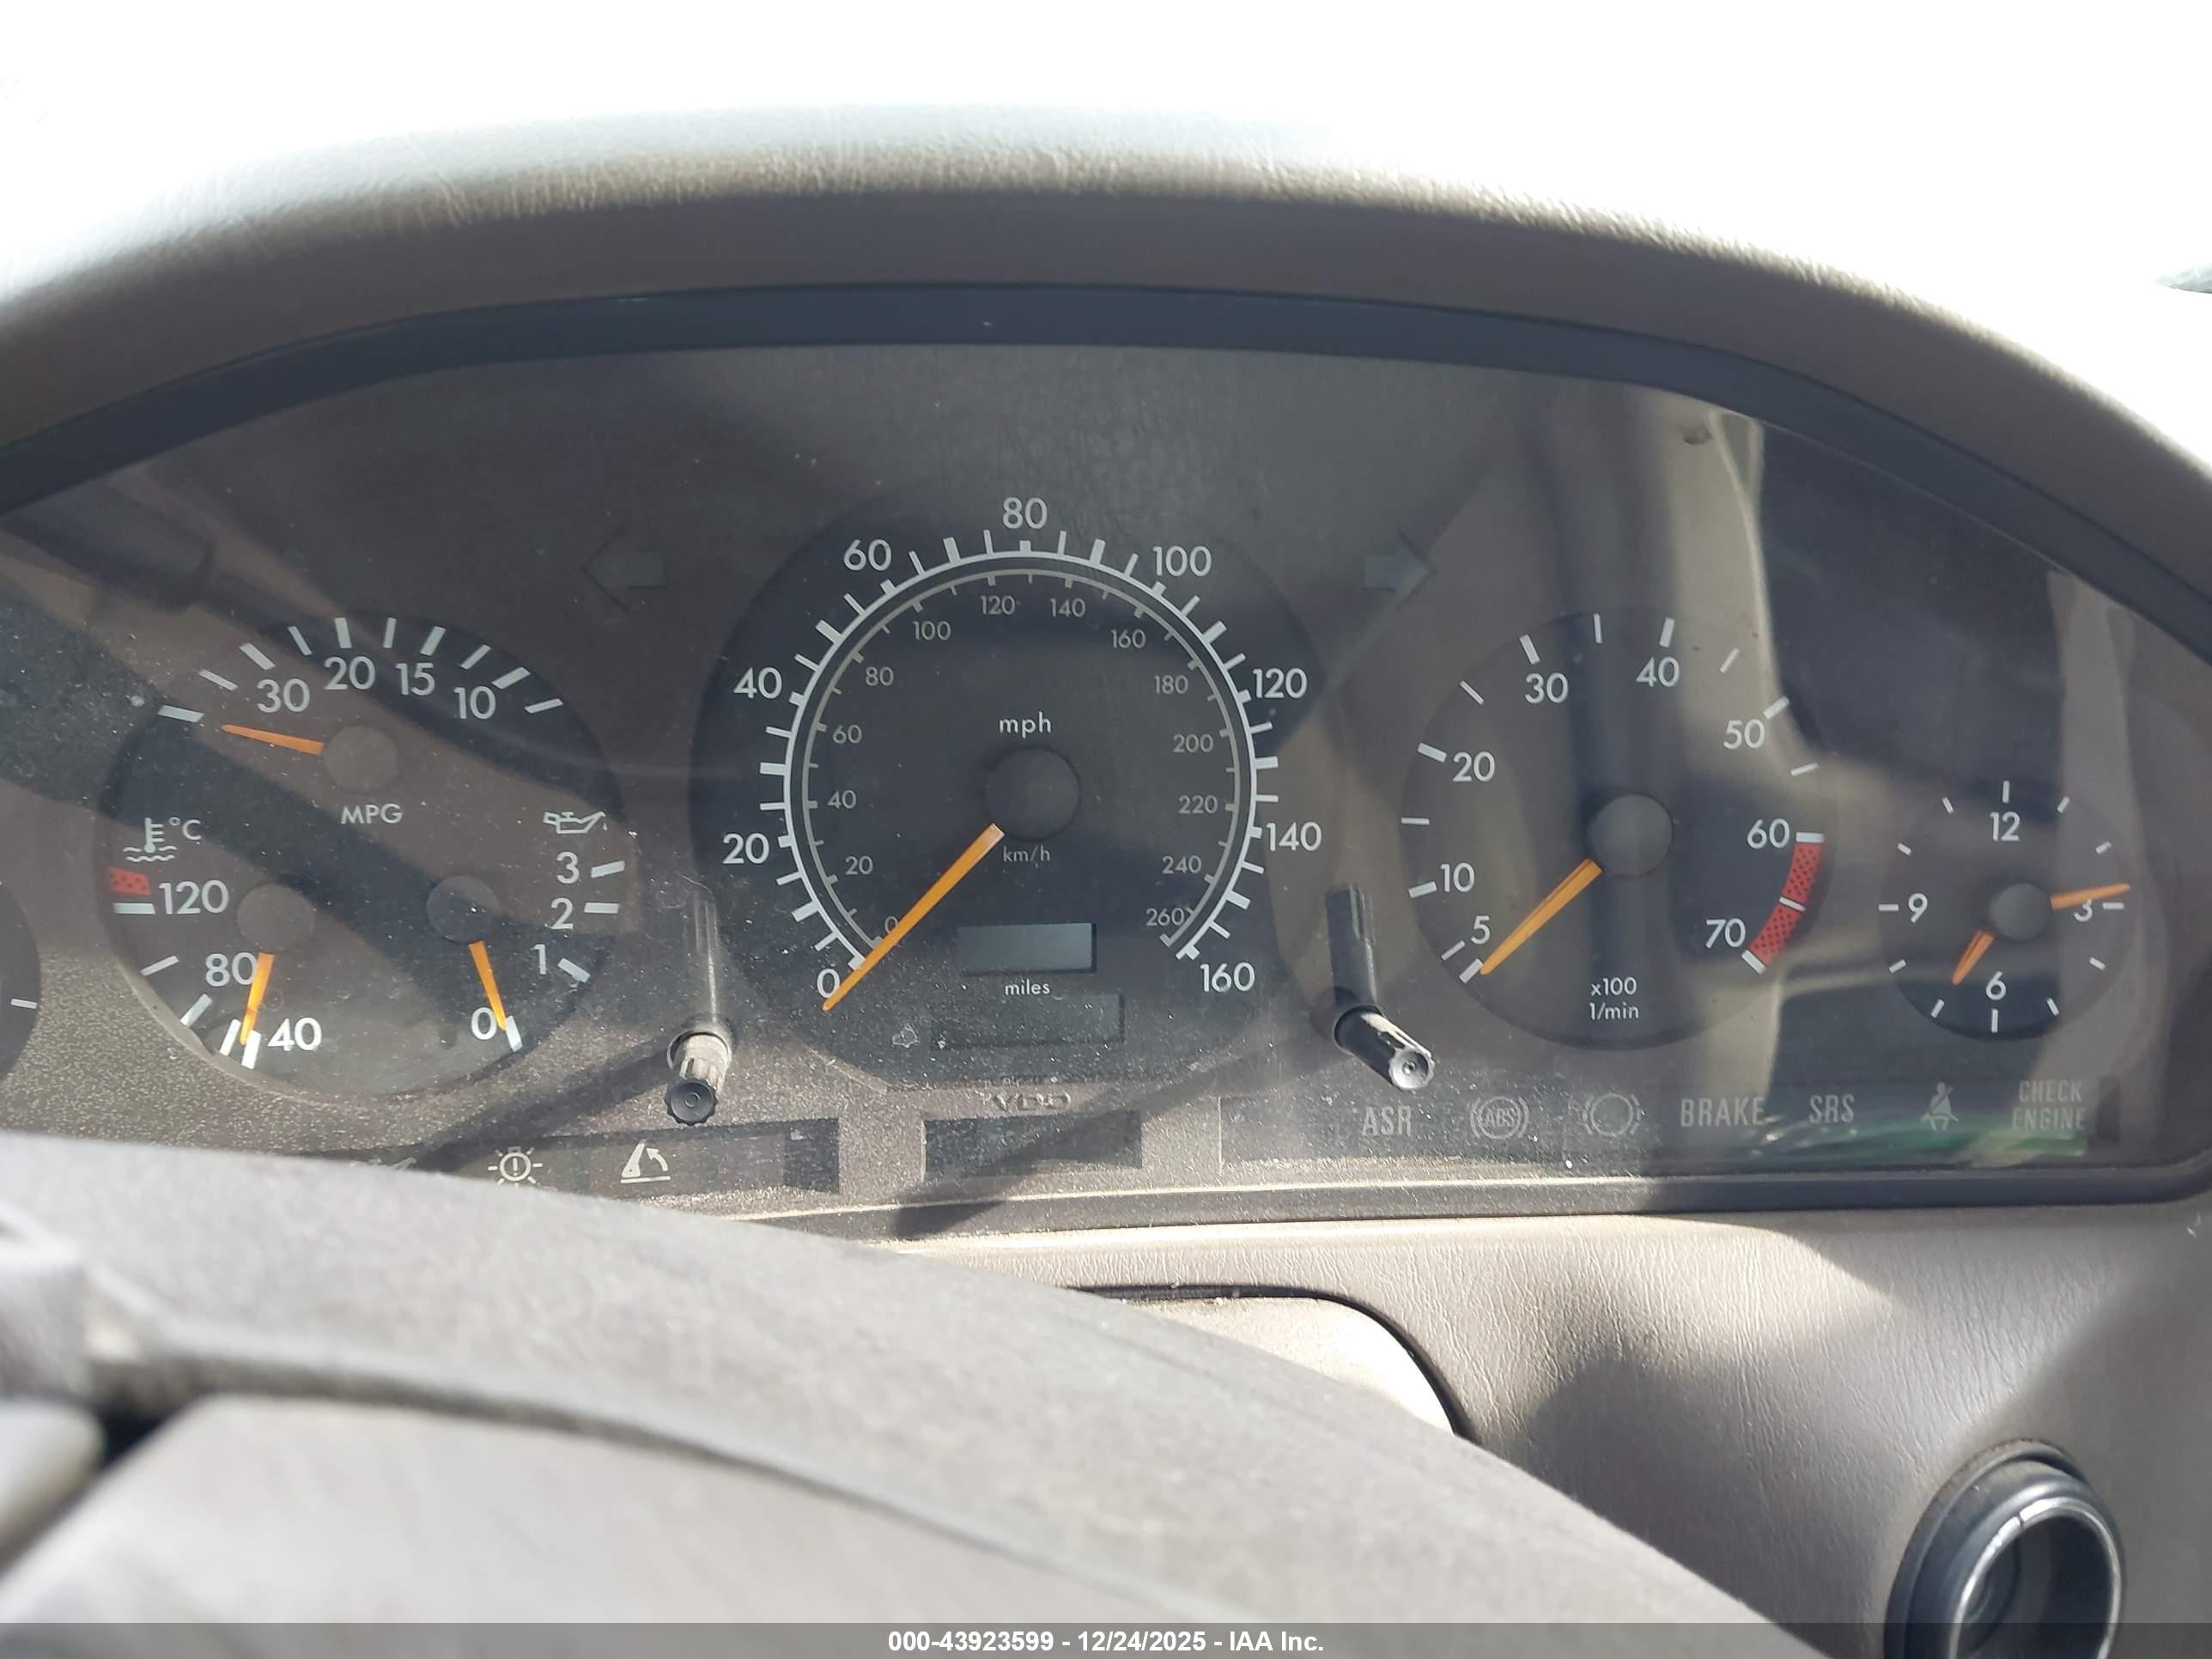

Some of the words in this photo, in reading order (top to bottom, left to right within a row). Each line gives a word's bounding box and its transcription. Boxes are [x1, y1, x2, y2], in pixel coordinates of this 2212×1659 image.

[1003, 497, 1047, 529] 80
[843, 539, 892, 570] 60
[1152, 546, 1212, 577] 100
[981, 595, 1015, 616] 120
[1051, 598, 1086, 617] 140
[913, 620, 951, 641] 100
[1111, 628, 1146, 649] 160
[325, 655, 374, 692] 20
[396, 663, 435, 696] 15
[734, 667, 782, 697] 40
[866, 666, 894, 687] 80
[1154, 673, 1188, 695] 180
[1253, 668, 1307, 698] 120
[1637, 657, 1680, 687] 40
[258, 679, 310, 713] 30
[1524, 673, 1568, 703] 30
[454, 687, 495, 720] 10
[834, 724, 862, 745] 60
[1000, 713, 1052, 738] mph
[1723, 720, 1765, 750] 50
[1173, 732, 1213, 754] 200
[1453, 751, 1495, 781] 20
[342, 804, 403, 824] MPG
[828, 790, 857, 809] 40
[1178, 794, 1218, 815] 220
[1266, 823, 1322, 851] 140
[1747, 818, 1790, 848] 60
[1990, 811, 2021, 842] 12
[723, 833, 769, 864] 20
[1003, 843, 1051, 864] km/h
[556, 855, 579, 884] 3
[845, 855, 873, 875] 20
[1163, 854, 1201, 875] 240
[1441, 863, 1474, 892] 10
[158, 879, 229, 915] 120
[1908, 894, 1928, 923] 9
[550, 898, 574, 930] 2
[1146, 906, 1186, 927] 260
[1471, 916, 1490, 945] 5
[1705, 918, 1746, 948] 70
[205, 952, 258, 988] 80
[533, 945, 548, 975] 1
[817, 969, 842, 997] 0
[1005, 979, 1050, 996] miles
[1200, 963, 1255, 993] 160
[1985, 972, 2006, 1000] 6
[471, 1008, 497, 1040] 0
[1589, 1002, 1639, 1020] 1/min
[268, 1018, 322, 1051] 40
[2019, 1079, 2082, 1104] CHECK
[1363, 1106, 1413, 1137] ASR
[1680, 1096, 1765, 1127] BRAKE
[1809, 1094, 1856, 1124] SRS
[2011, 1108, 2087, 1132] ENGINE
